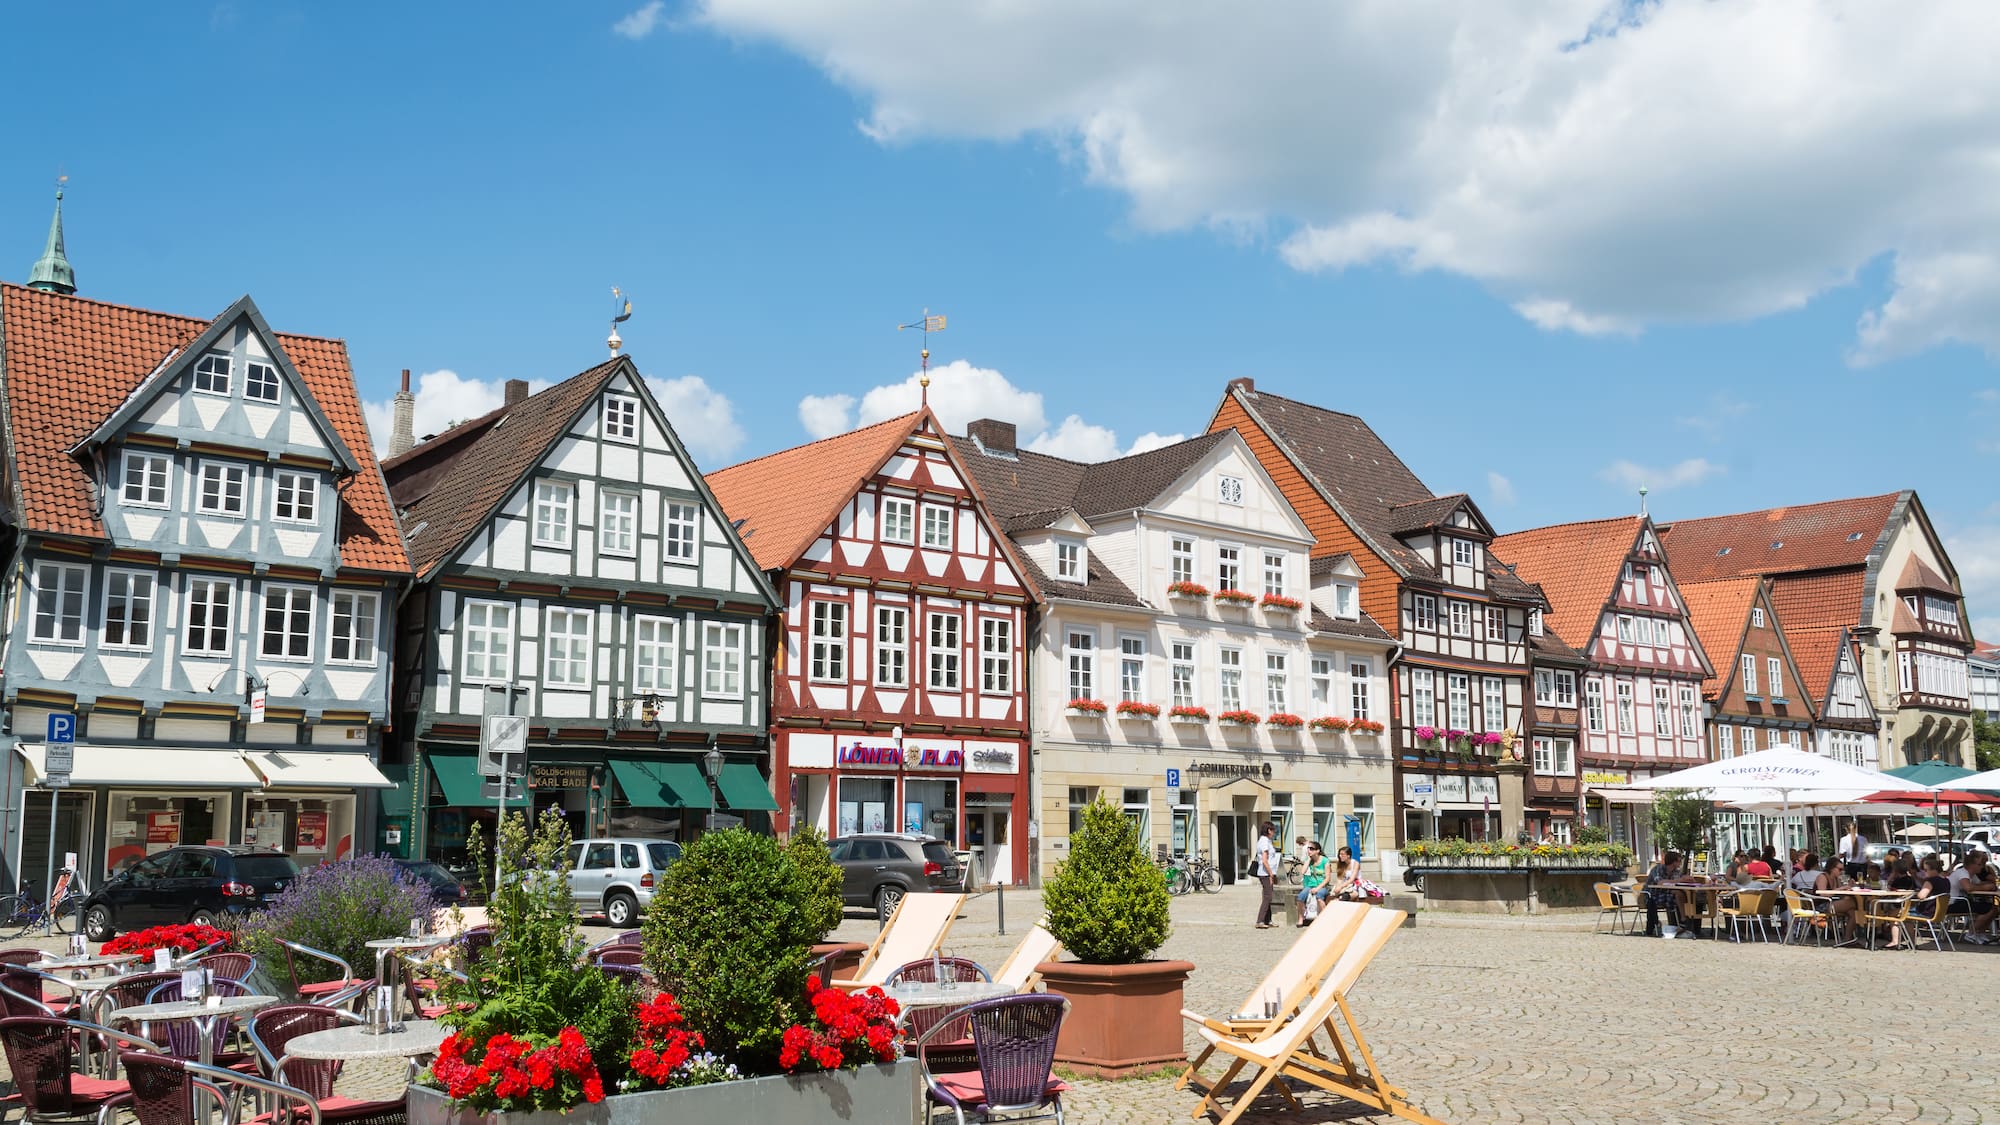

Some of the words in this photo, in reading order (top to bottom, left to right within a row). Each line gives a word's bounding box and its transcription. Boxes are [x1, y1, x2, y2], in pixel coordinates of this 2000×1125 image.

[53, 717, 69, 739] P
[839, 742, 904, 764] LÖWEN
[921, 749, 965, 766] PLAY
[535, 768, 587, 777] GOLDSCHMIED
[1721, 766, 1820, 777] GEROLSTEINER
[535, 778, 560, 787] KARL
[562, 778, 587, 787] BADE
